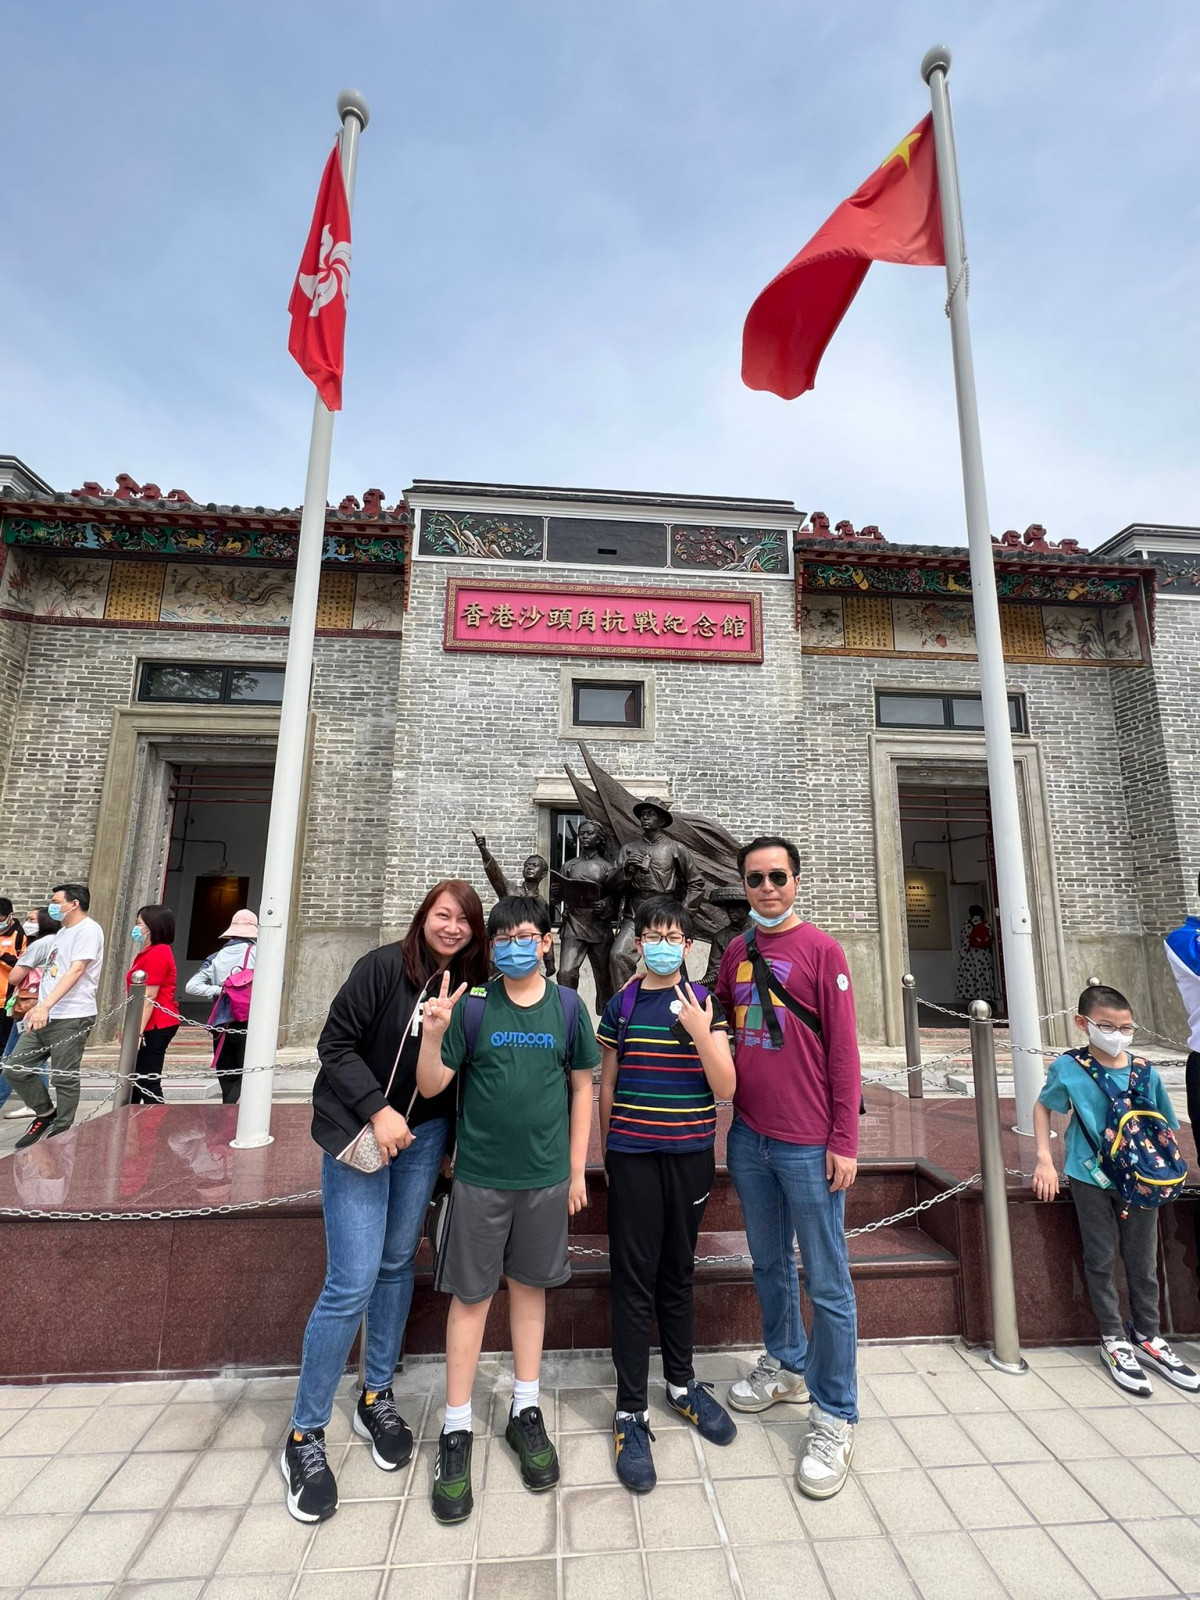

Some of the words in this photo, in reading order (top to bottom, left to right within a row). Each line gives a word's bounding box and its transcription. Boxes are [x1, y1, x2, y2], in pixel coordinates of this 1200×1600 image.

[461, 602, 748, 638] 香港沙頭角抗戰紀念館
[490, 1031, 554, 1048] OUTDOOR
